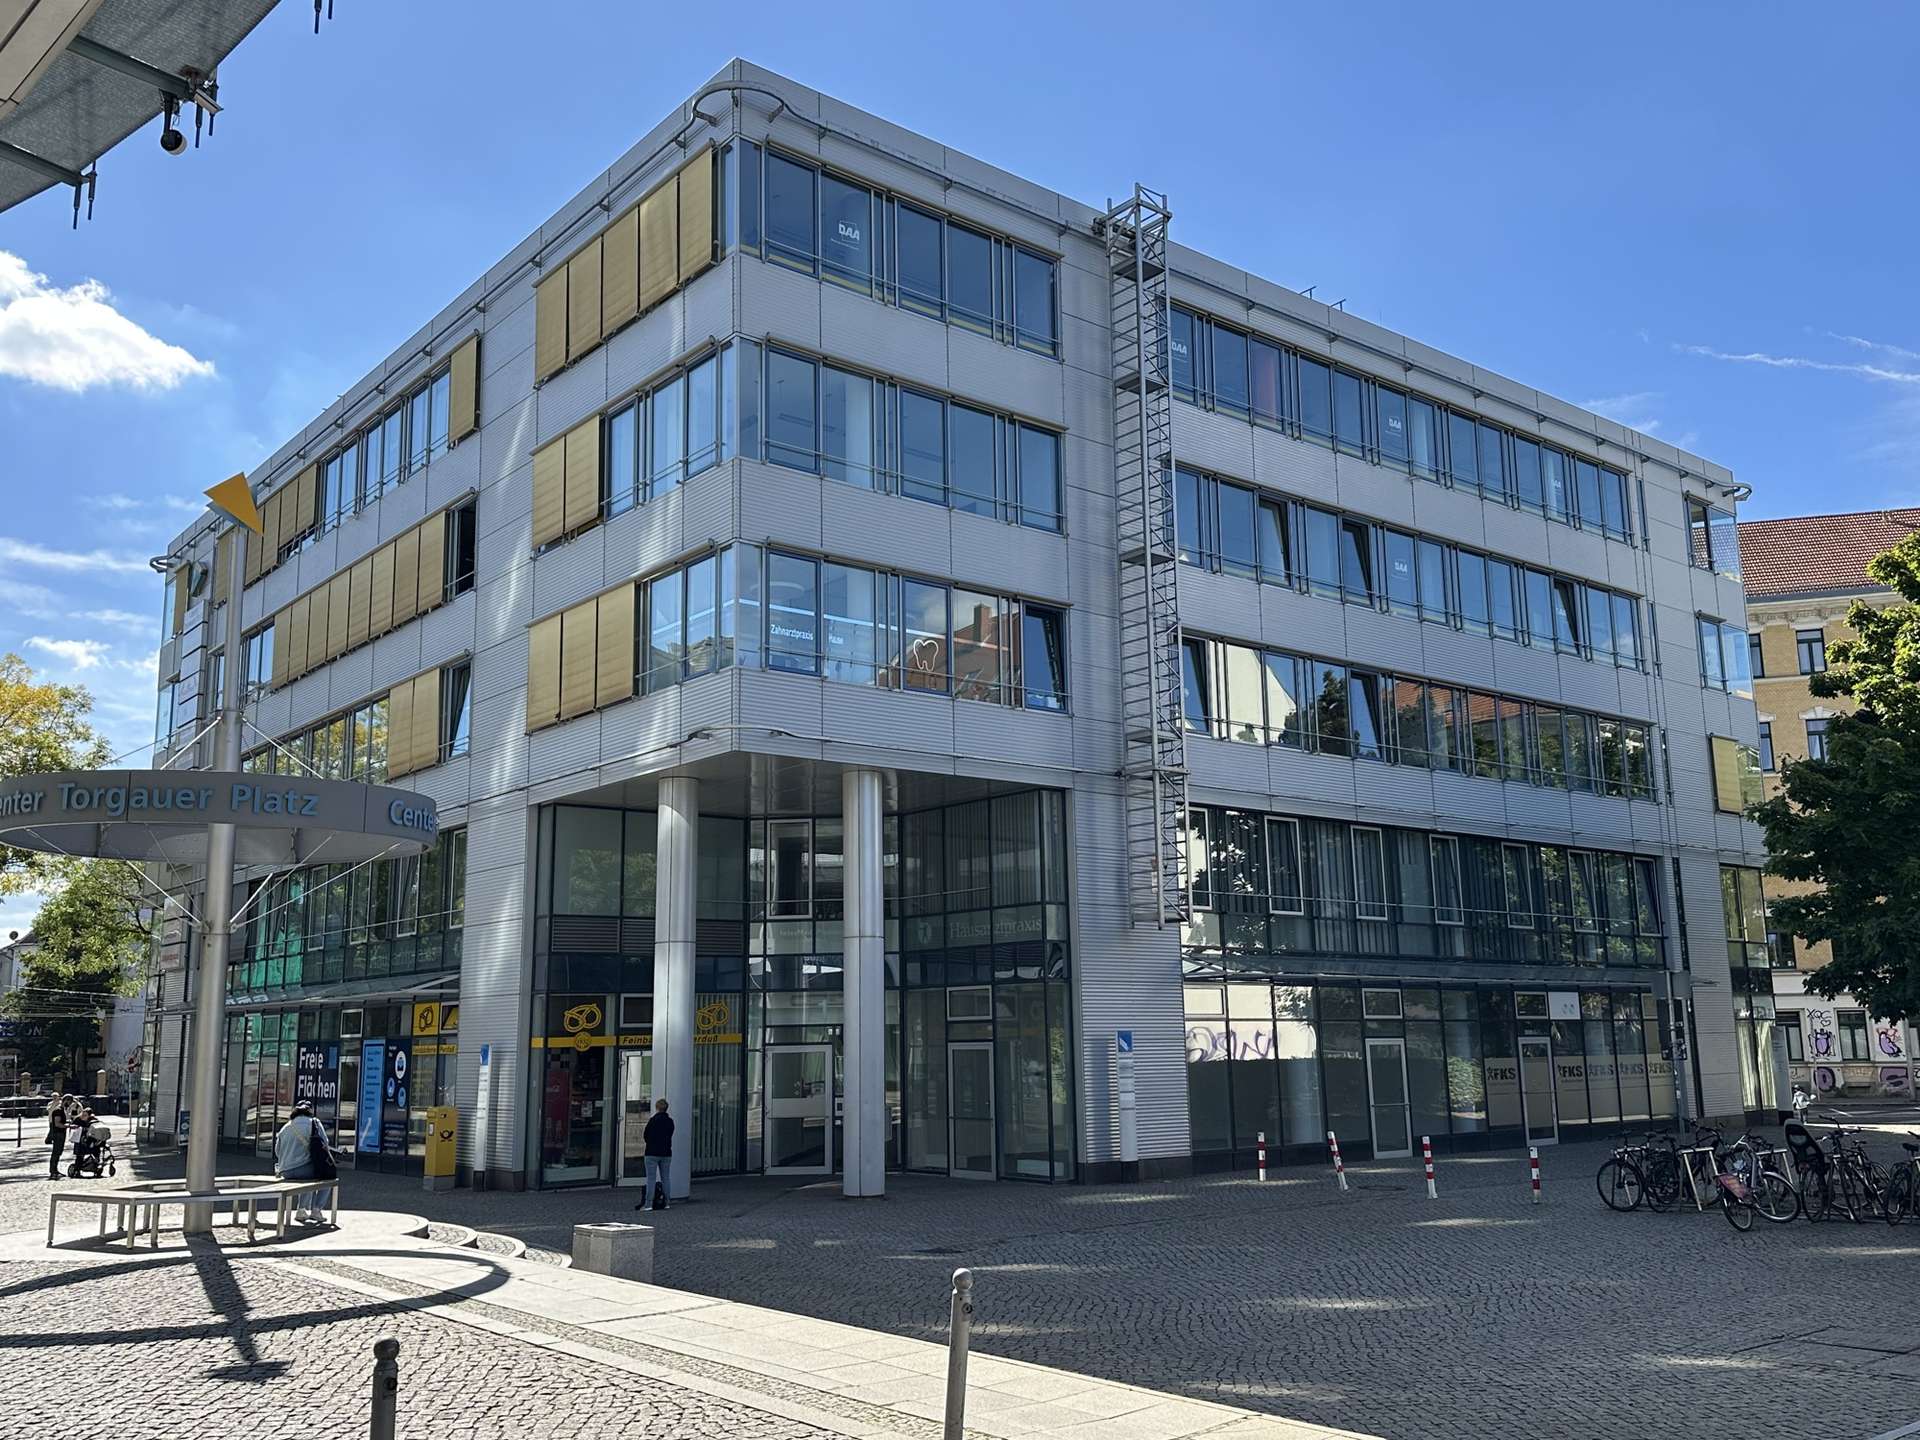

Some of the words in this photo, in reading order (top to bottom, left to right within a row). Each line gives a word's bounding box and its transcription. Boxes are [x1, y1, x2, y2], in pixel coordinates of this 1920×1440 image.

[838, 223, 860, 241] DAA
[1171, 341, 1187, 355] DAA
[770, 623, 814, 641] Zahnarztpraxis
[0, 789, 44, 816] nter
[58, 782, 213, 817] Torgauer
[231, 783, 320, 816] Platz
[299, 1046, 324, 1070] Freie
[1494, 1067, 1516, 1081] FKS
[1563, 1065, 1583, 1078] FKS
[297, 1075, 336, 1099] Flächen
